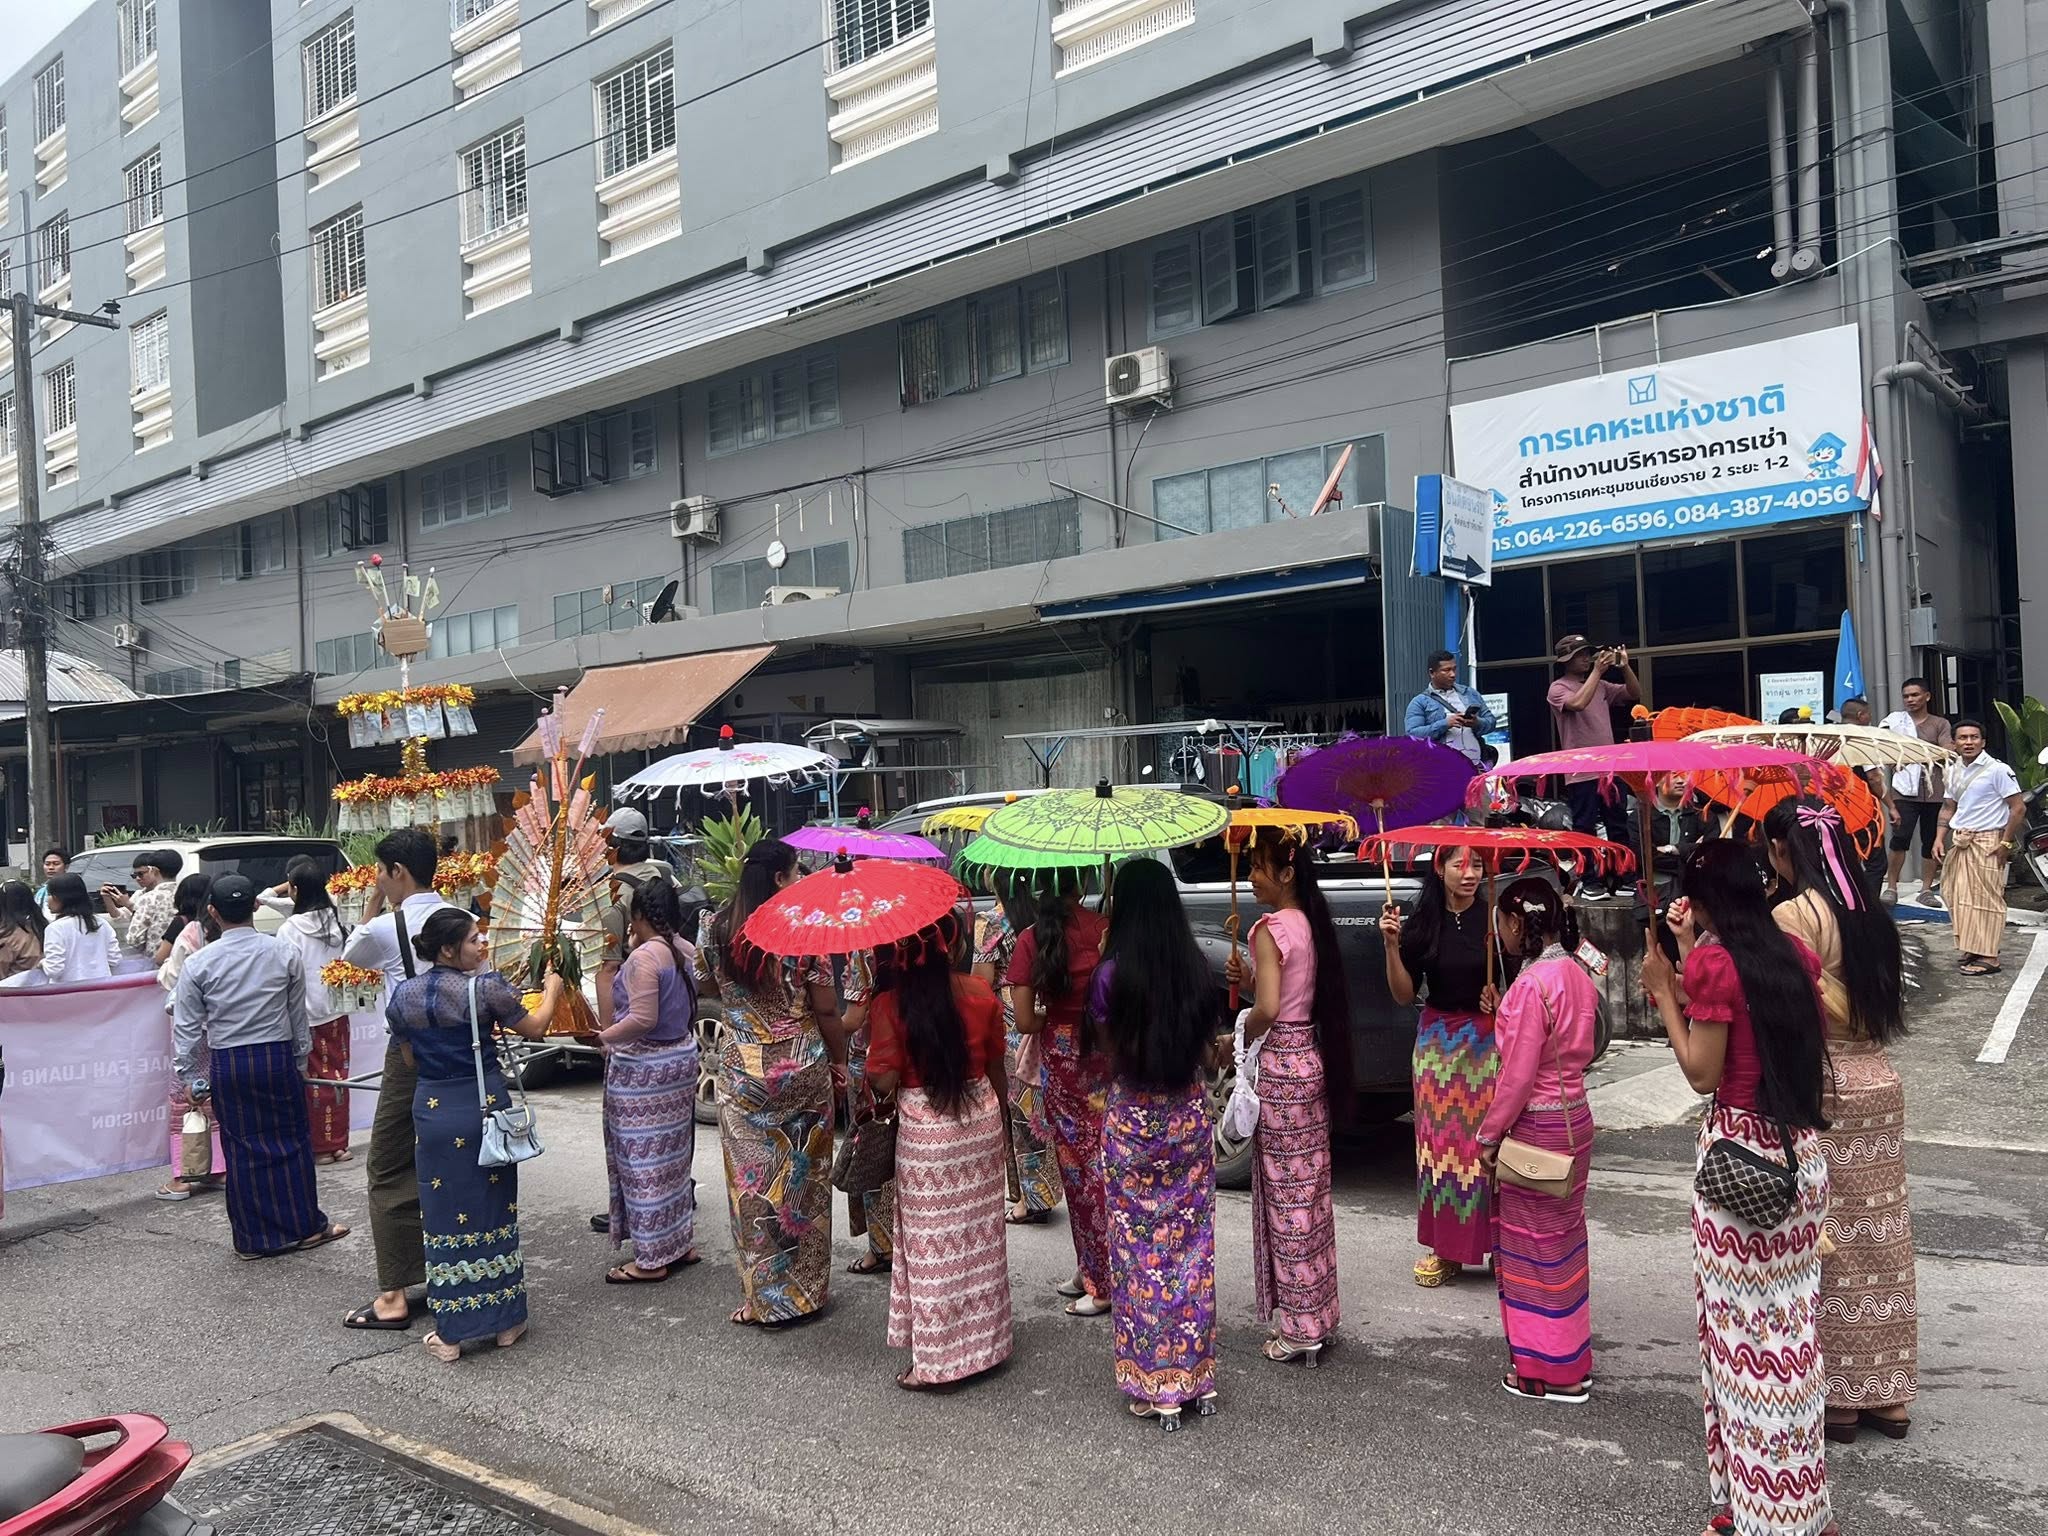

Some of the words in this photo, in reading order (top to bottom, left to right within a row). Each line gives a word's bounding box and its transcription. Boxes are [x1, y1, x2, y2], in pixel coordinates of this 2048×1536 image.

[1518, 383, 1785, 457] การเคหะแห่งชาติ
[1519, 426, 1787, 488] สำนักงานบริหารอาคารเช่า
[1521, 470, 1706, 508] โครงการเคหะชุมชนเชียงราย
[1711, 466, 1722, 479] 2
[1727, 462, 1760, 477] ระยะ
[1764, 455, 1790, 470] 1-2
